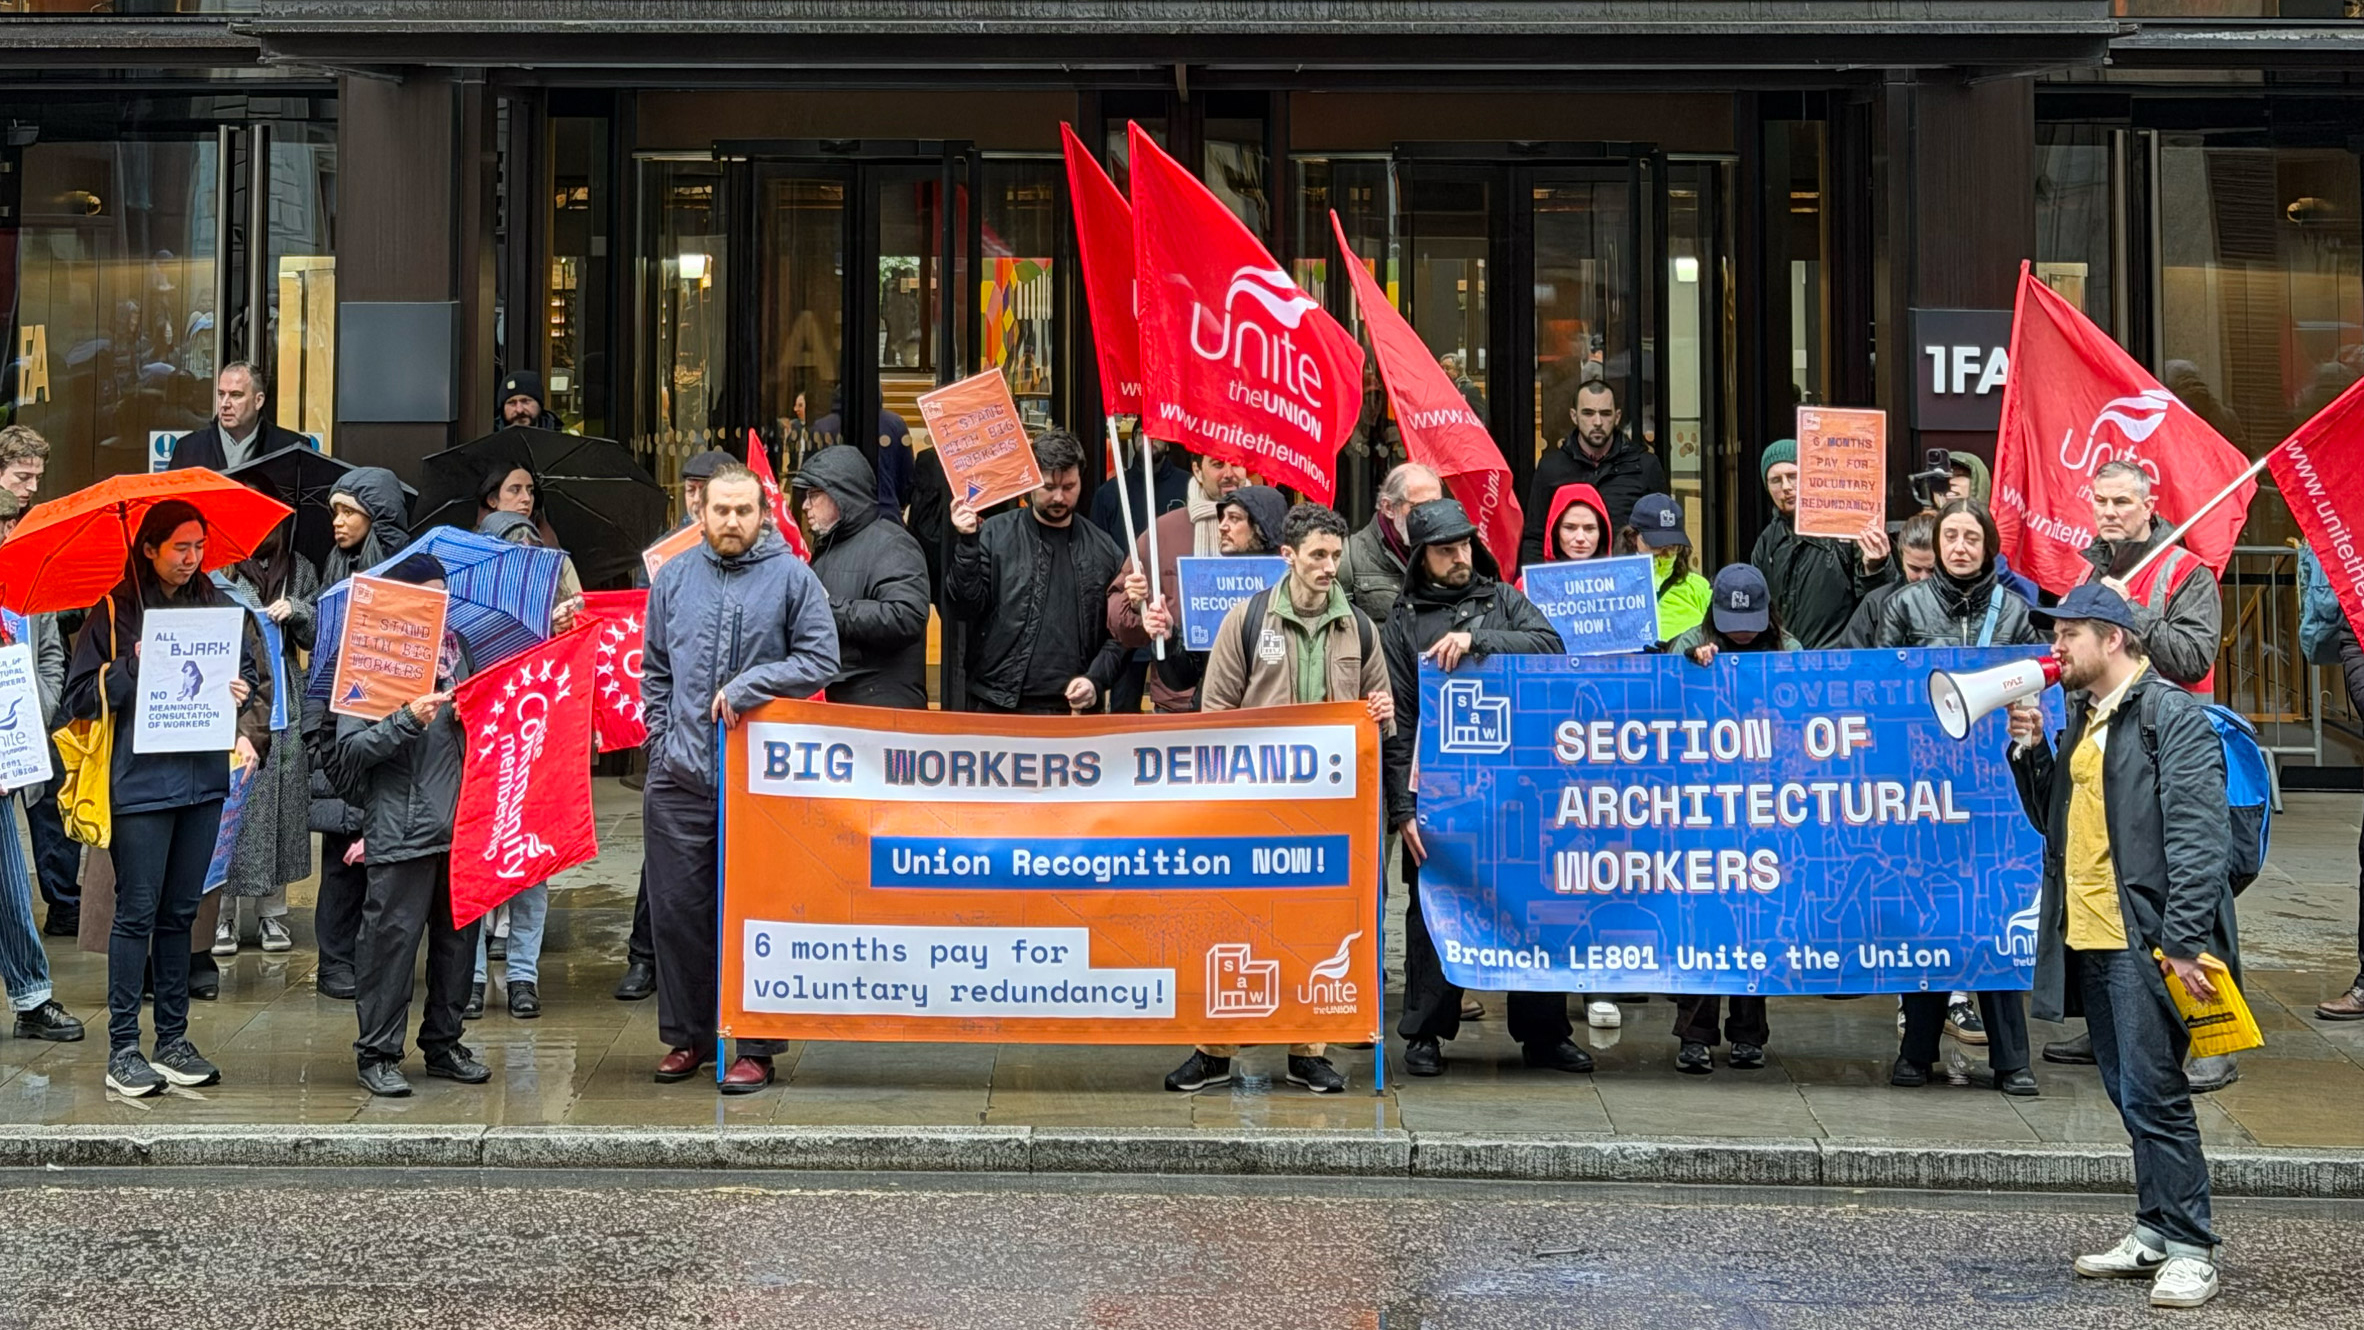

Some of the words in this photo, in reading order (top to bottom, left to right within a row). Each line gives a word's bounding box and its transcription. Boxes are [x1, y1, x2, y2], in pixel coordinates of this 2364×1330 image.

[1925, 345, 2009, 394] 1FA
[986, 419, 1015, 438] BIG
[952, 438, 1017, 471] WORKERS
[1827, 437, 1873, 449] MONTHS
[1817, 457, 1838, 468] PAY
[1846, 459, 1868, 469] FOR
[1809, 478, 1876, 491] VOLUNTARY
[1217, 576, 1264, 591] UNION
[1565, 577, 1615, 595] UNION
[1537, 594, 1646, 617] RECOGNITION
[155, 632, 177, 642] ALL
[361, 613, 369, 627] I
[380, 618, 430, 638] STAND
[1573, 619, 1612, 635] NOW!
[351, 633, 392, 653] WITH
[401, 642, 432, 660] BIG
[352, 654, 424, 679] WORKERS
[149, 703, 211, 712] MEANINGFUL
[150, 691, 168, 700] NO
[148, 711, 219, 720] CONSULTATION
[148, 721, 161, 729] OF
[163, 719, 211, 729] WORKERS
[1555, 718, 1772, 763] SECTION
[1805, 716, 1870, 760] OF
[763, 740, 854, 783] BIG
[883, 748, 1101, 787] WORKERS
[1133, 744, 1342, 786] DEMAND:
[483, 733, 515, 862] membership
[1555, 780, 1971, 828] ARCHITECTURAL
[891, 847, 990, 875] Union
[1012, 847, 1231, 882] Recognition
[1251, 846, 1326, 874] NOW!
[1555, 850, 1781, 893] WORKERS
[754, 932, 771, 958] 6
[791, 937, 908, 962] months
[929, 943, 989, 969] pay
[1010, 939, 1069, 963] for
[1445, 940, 1550, 969] Branch
[1569, 945, 1659, 970] LE801
[1677, 944, 1768, 970] Unite
[1785, 945, 1841, 969] the
[1859, 942, 1951, 967] Union
[753, 975, 929, 1008] voluntary
[949, 979, 1165, 1010] redundancy!
